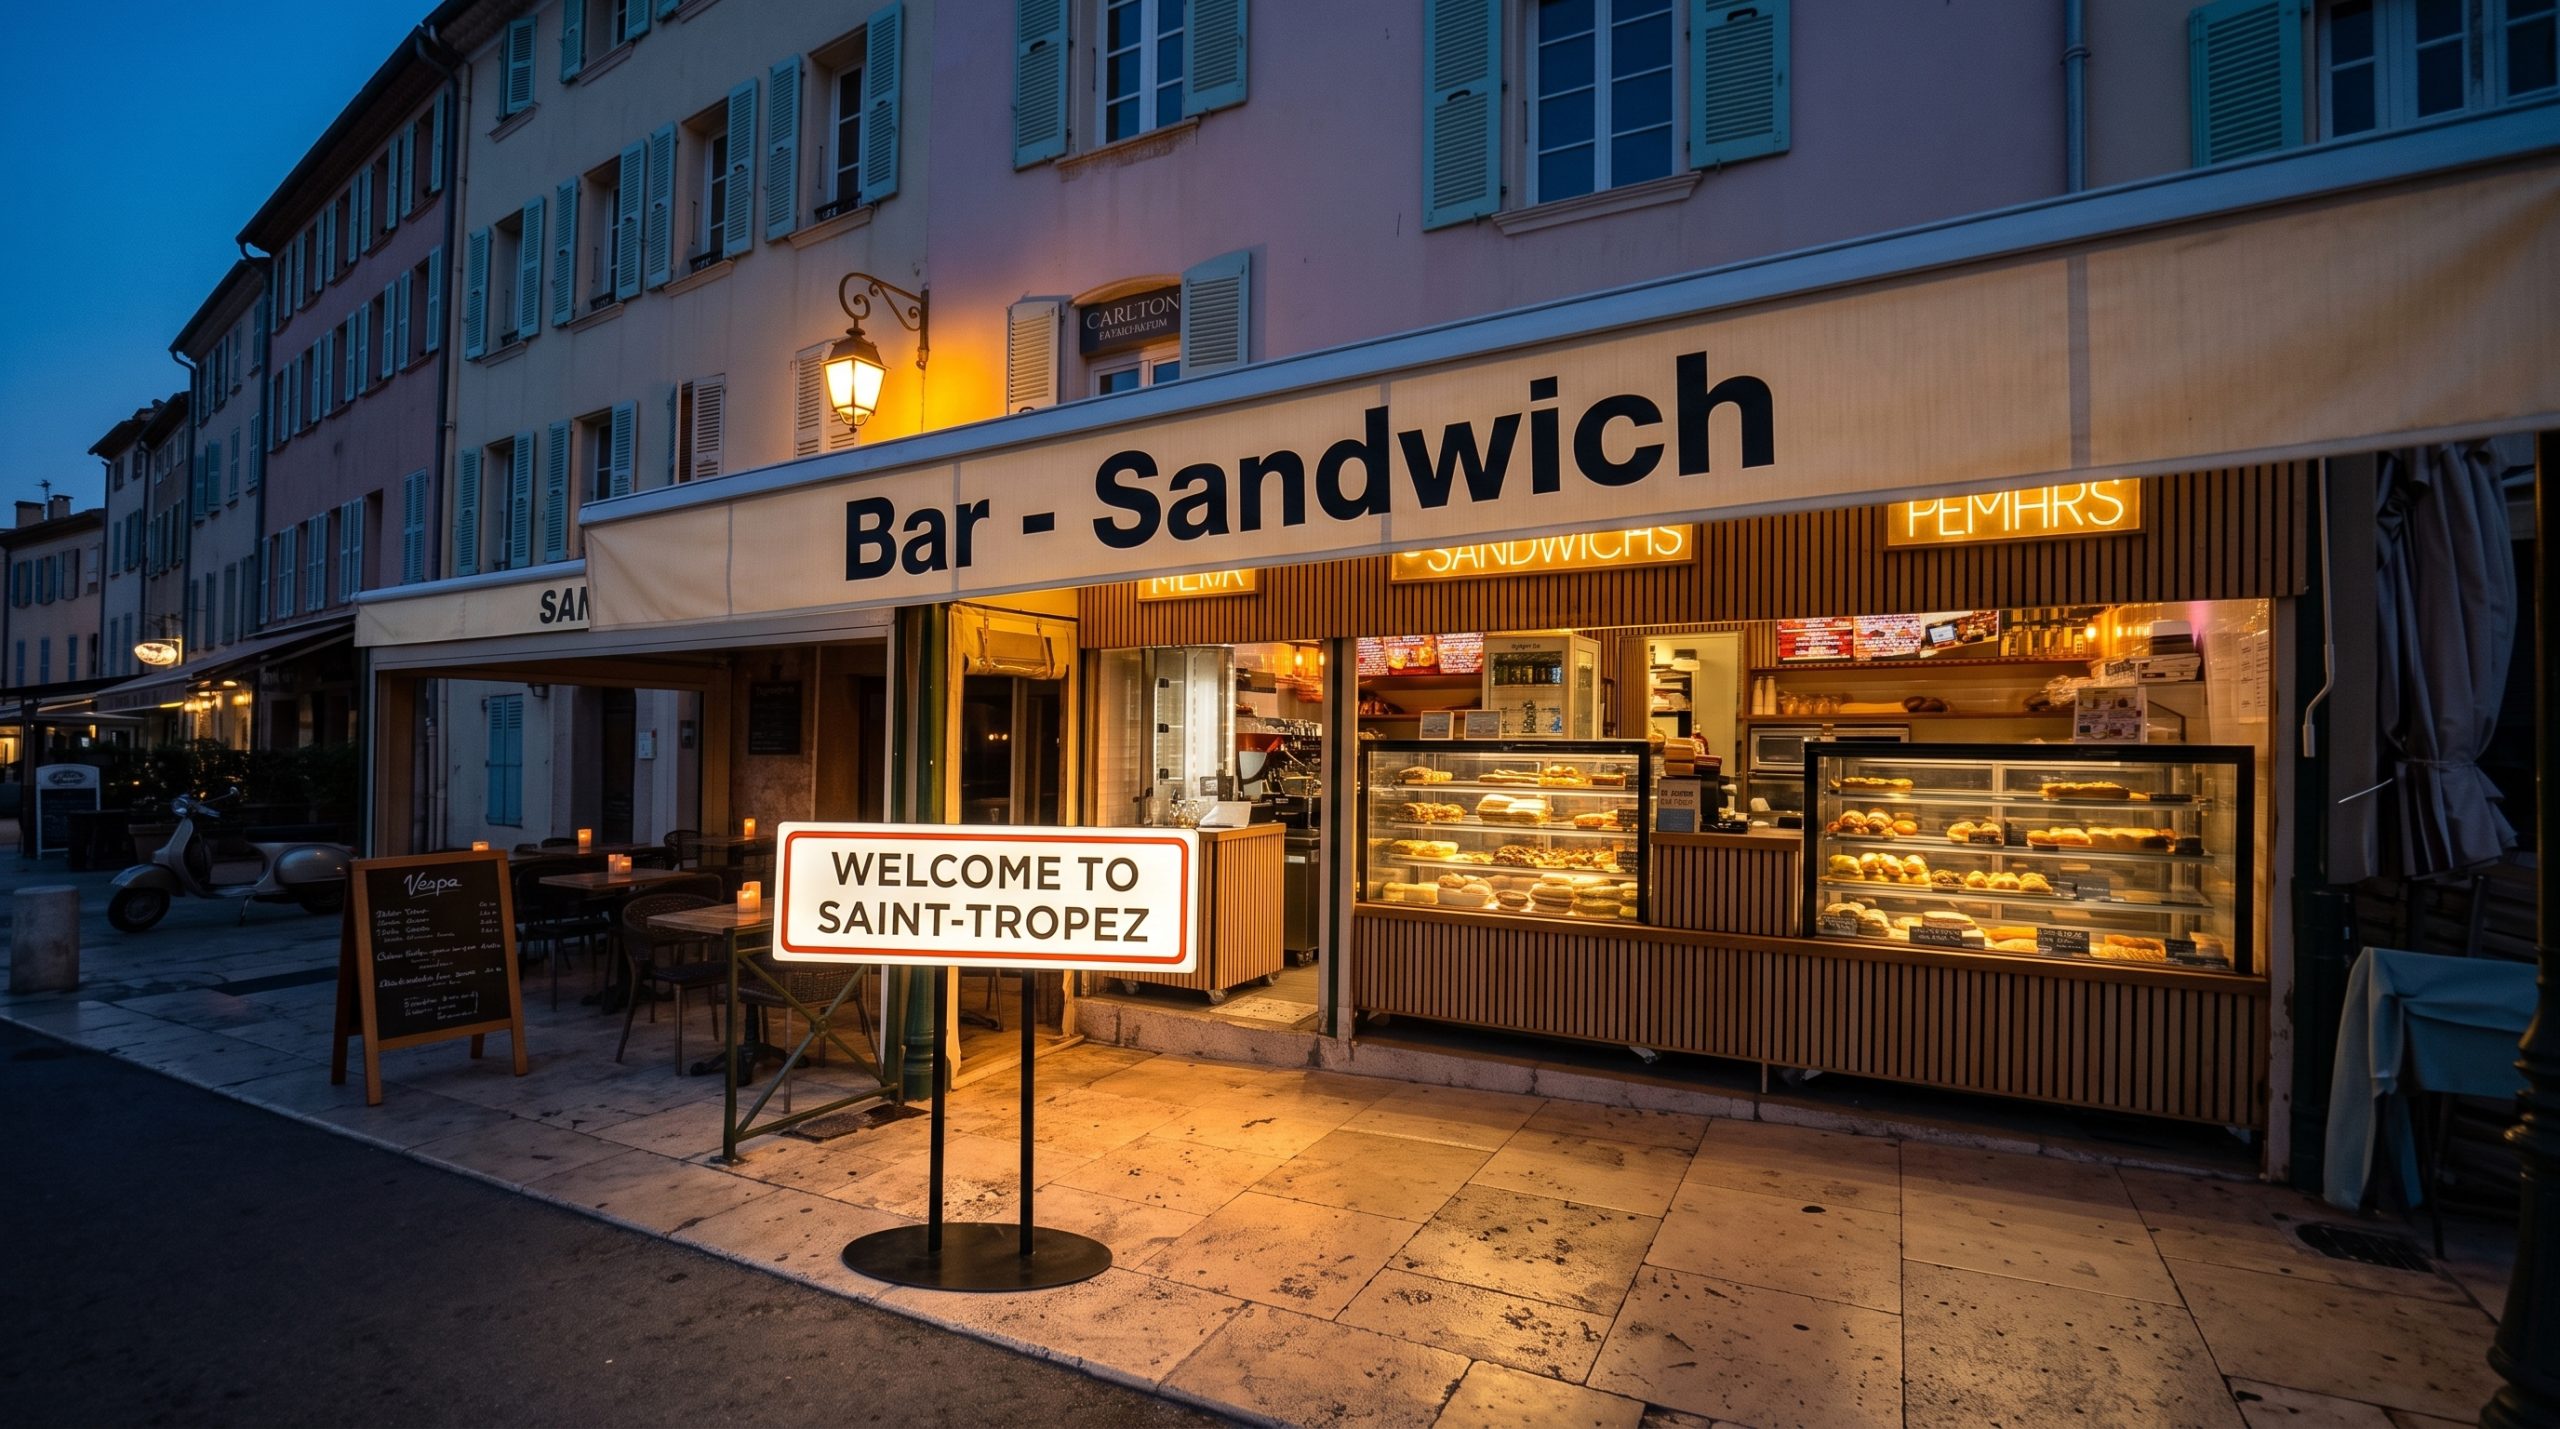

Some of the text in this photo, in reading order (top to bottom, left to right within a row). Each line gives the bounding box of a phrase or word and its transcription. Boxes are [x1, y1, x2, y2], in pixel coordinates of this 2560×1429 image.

[1086, 293, 1180, 330] CARLTON
[845, 496, 990, 582] Bar
[1092, 351, 1776, 549] Sandwich
[403, 872, 463, 897] Vespa
[832, 851, 1140, 892] WELCOME TO
[817, 900, 1150, 943] SAINT-TROPEZ
